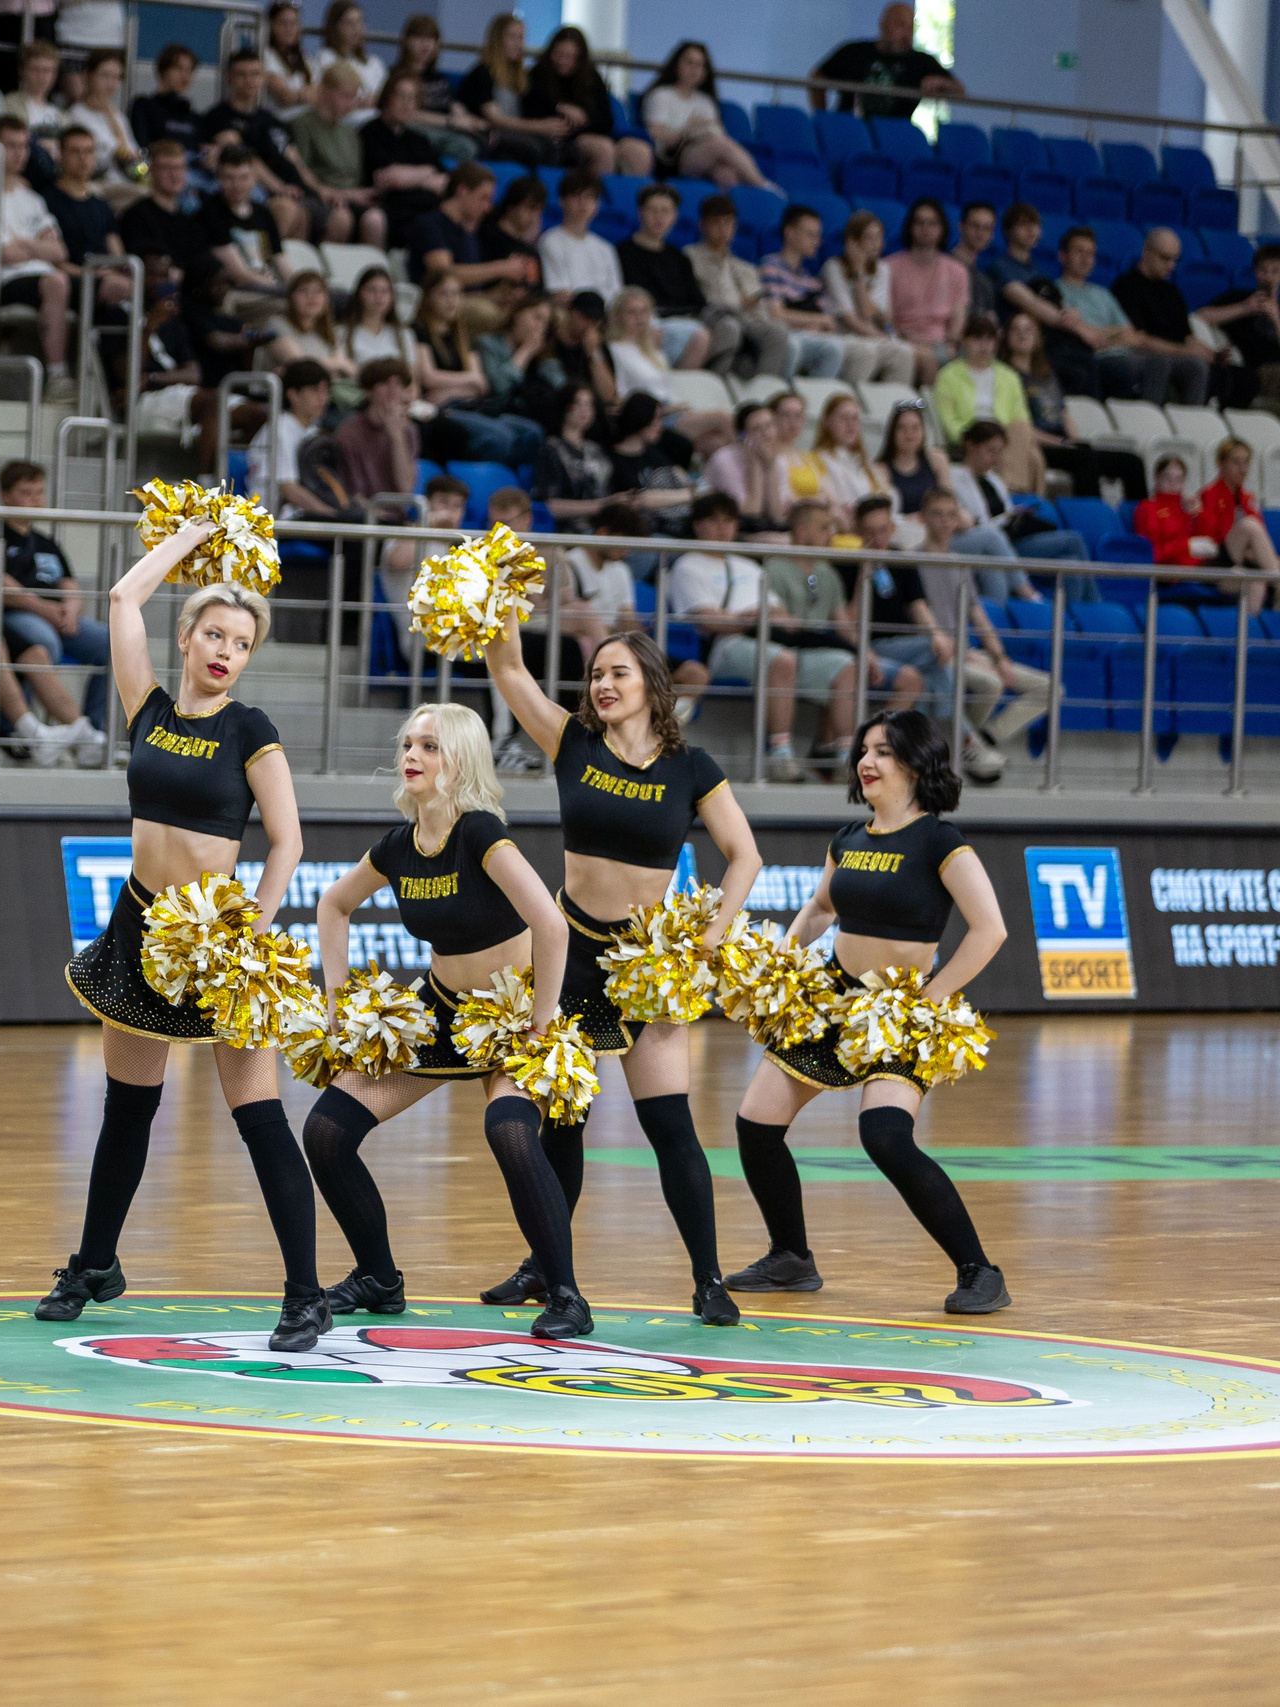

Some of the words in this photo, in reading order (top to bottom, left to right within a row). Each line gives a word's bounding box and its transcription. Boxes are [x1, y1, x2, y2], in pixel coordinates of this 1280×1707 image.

[145, 725, 220, 760] TIMEOUT
[580, 764, 666, 802] TIMEOUT
[838, 850, 905, 873] TIMEOUT
[400, 871, 459, 899] TIMEOUT
[1036, 863, 1108, 930] TV
[1048, 960, 1123, 990] SPORT
